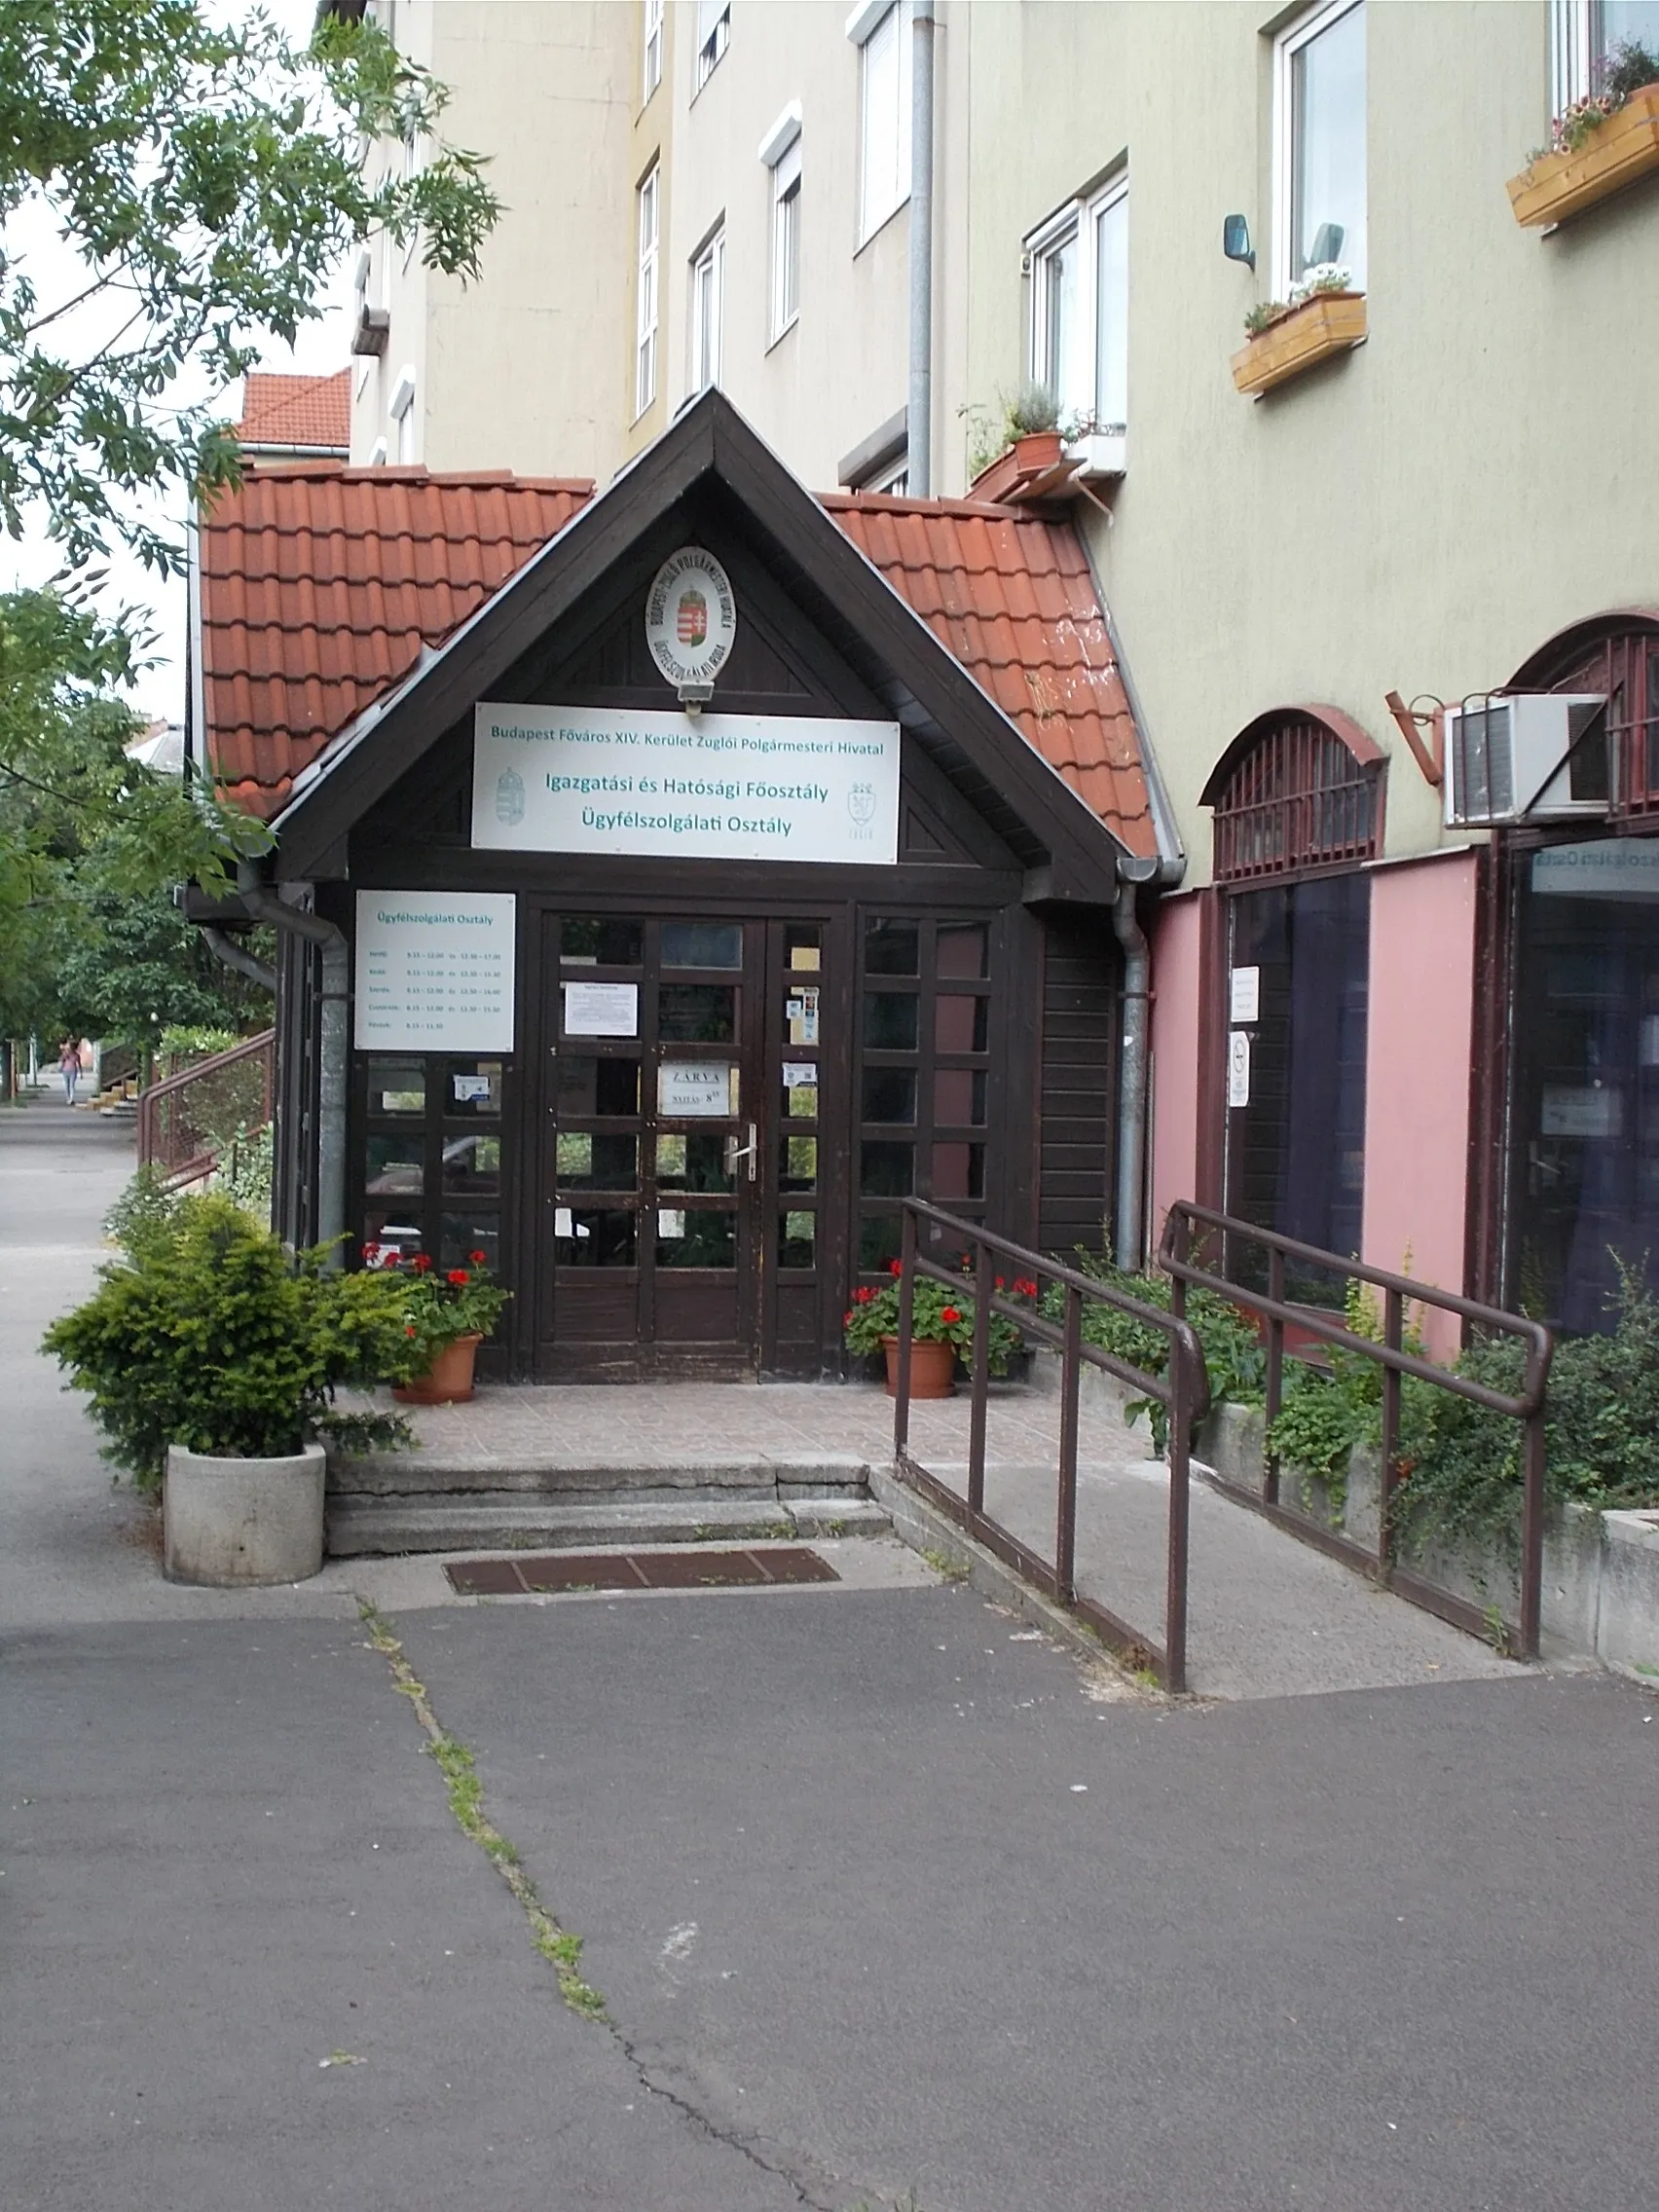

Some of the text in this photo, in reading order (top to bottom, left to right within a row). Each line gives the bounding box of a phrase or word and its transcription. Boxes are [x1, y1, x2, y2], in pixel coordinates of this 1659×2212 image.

[492, 725, 886, 756] Budapest Főváros XIV. Kerület Zuglói Polgármesteri Hivatal
[546, 773, 829, 803] Igazgatási és Hatósági Főosztály
[582, 806, 792, 837] Ügyfélszolgálati Osztály
[377, 911, 494, 927] Ügyfélszolgálati Osztály
[673, 1070, 719, 1082] ZÁRVA
